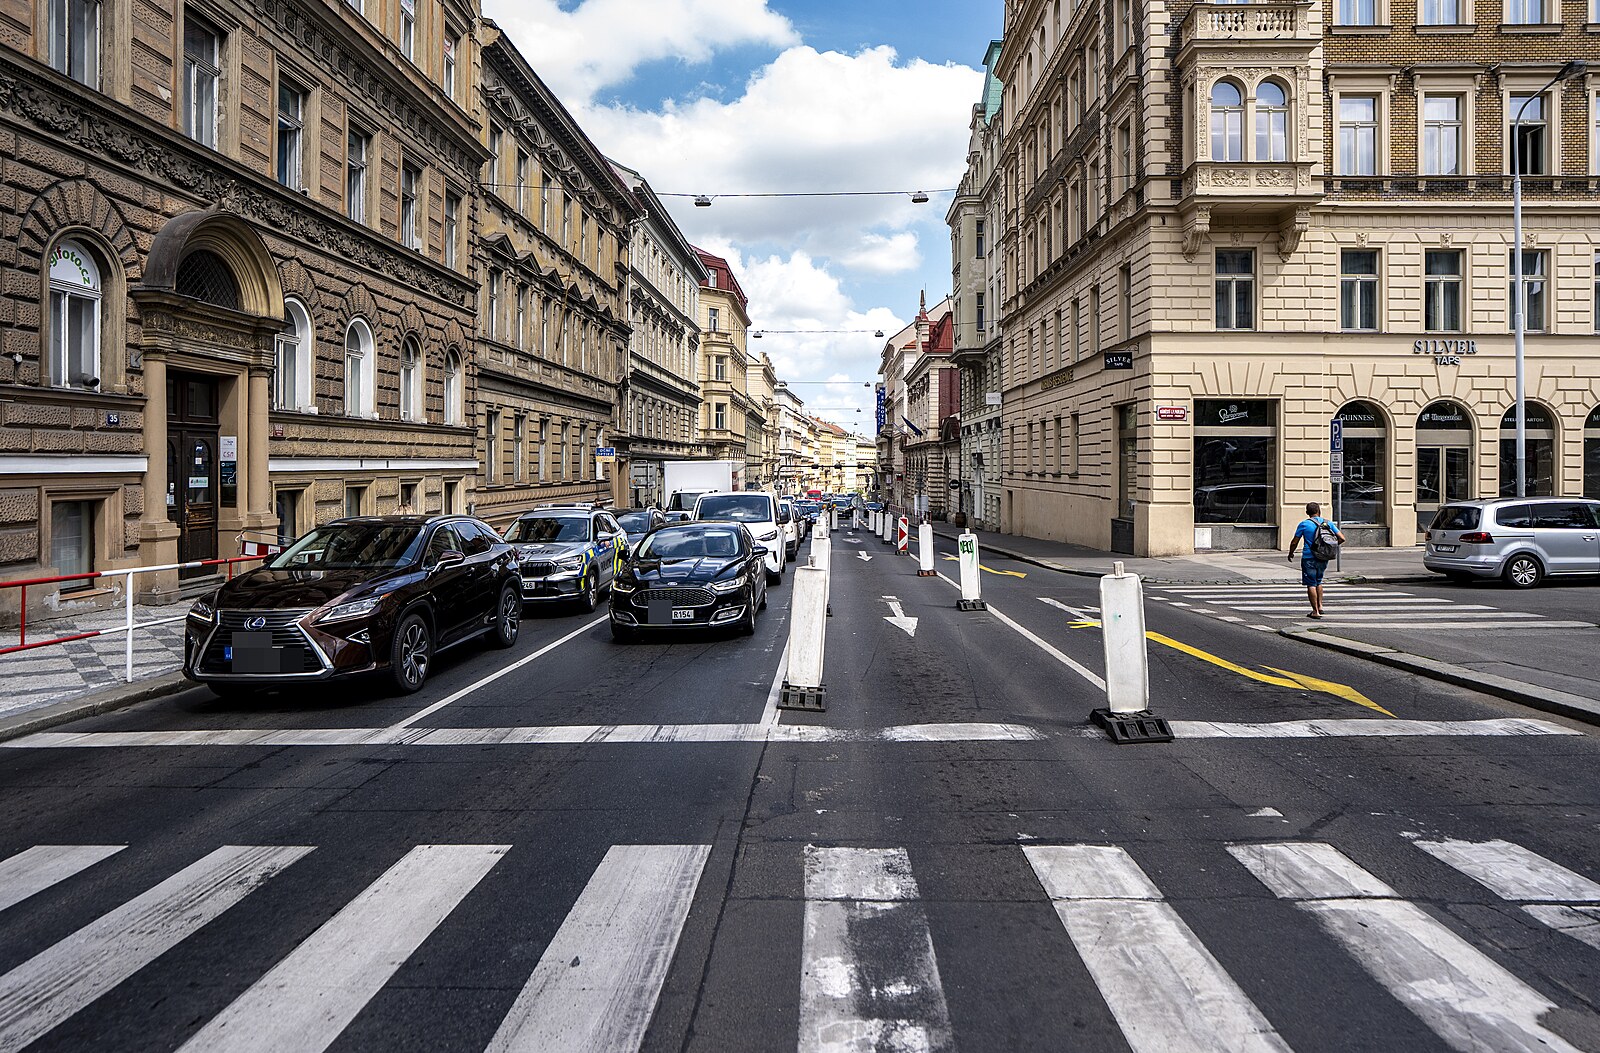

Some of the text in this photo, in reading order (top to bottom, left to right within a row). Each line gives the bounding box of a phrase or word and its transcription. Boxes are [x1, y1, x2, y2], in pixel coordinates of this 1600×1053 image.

[1413, 339, 1478, 354] SILVER
[1106, 356, 1131, 365] SILVER
[1435, 356, 1461, 366] TAPS
[109, 414, 118, 423] 35
[1339, 413, 1375, 421] GUINNESS
[1332, 423, 1340, 442] P
